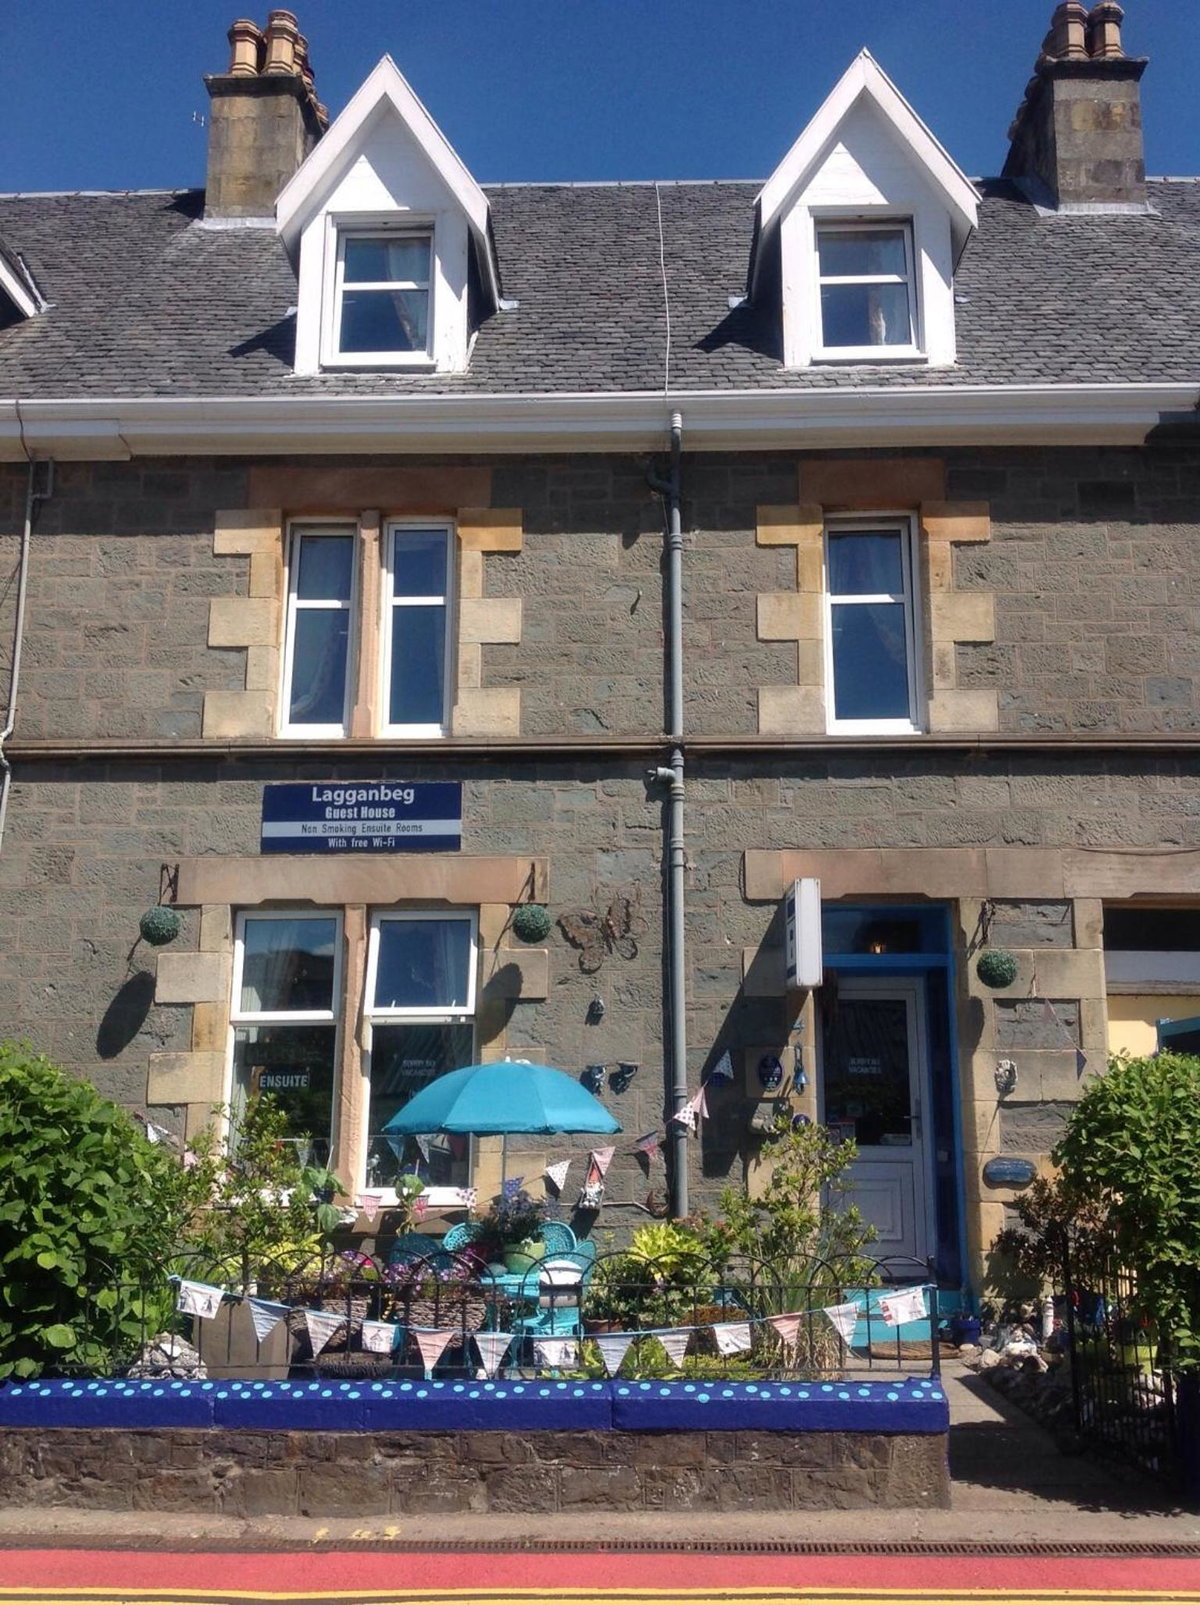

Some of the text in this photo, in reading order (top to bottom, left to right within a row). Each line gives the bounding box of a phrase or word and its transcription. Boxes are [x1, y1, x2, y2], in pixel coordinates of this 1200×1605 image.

[312, 785, 415, 805] Lagganbeg
[325, 806, 395, 819] Guest House
[301, 822, 423, 835] Non Smoking Ensuite Rooms
[328, 836, 395, 848] With free Wi-Fi
[259, 1074, 308, 1088] ENSUITE
